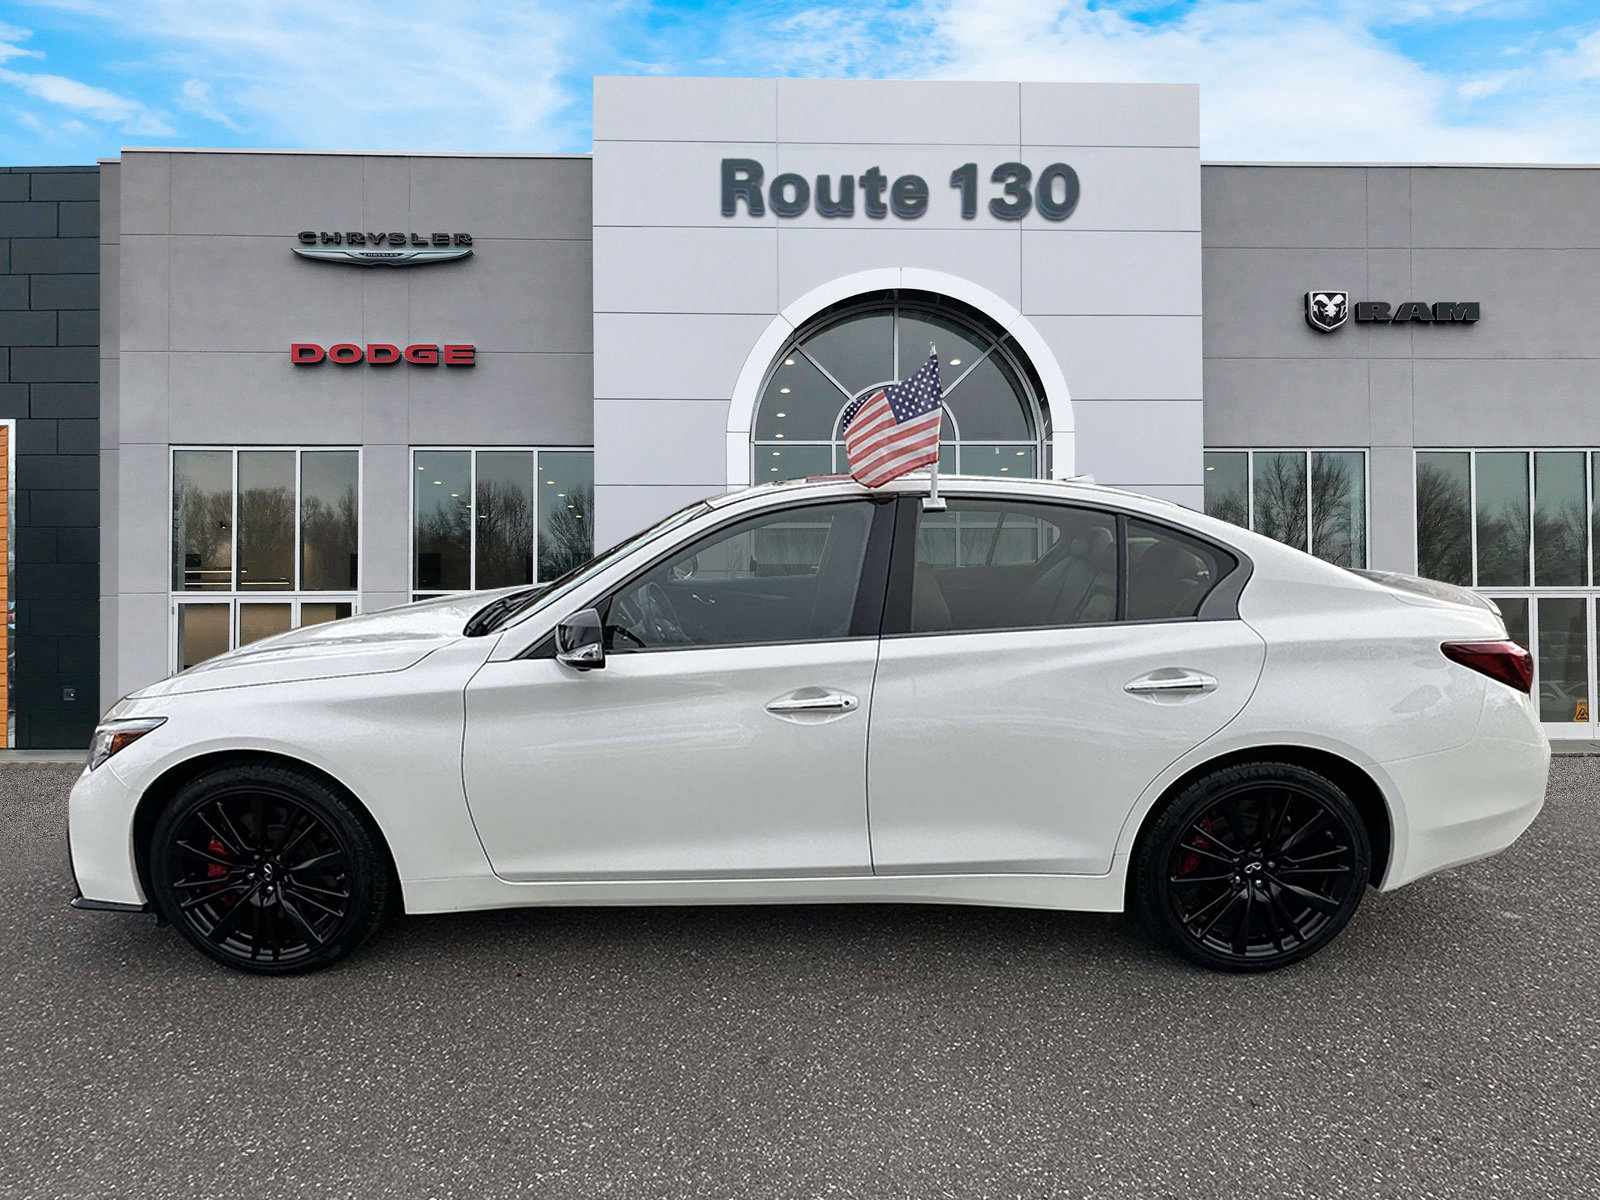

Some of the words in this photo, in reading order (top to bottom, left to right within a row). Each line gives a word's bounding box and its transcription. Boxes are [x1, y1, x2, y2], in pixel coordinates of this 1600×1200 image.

[721, 158, 929, 217] Route
[950, 161, 1080, 220] 130
[298, 231, 473, 245] CHRYSLER
[1355, 302, 1480, 323] RAM
[291, 343, 475, 366] DODGE
